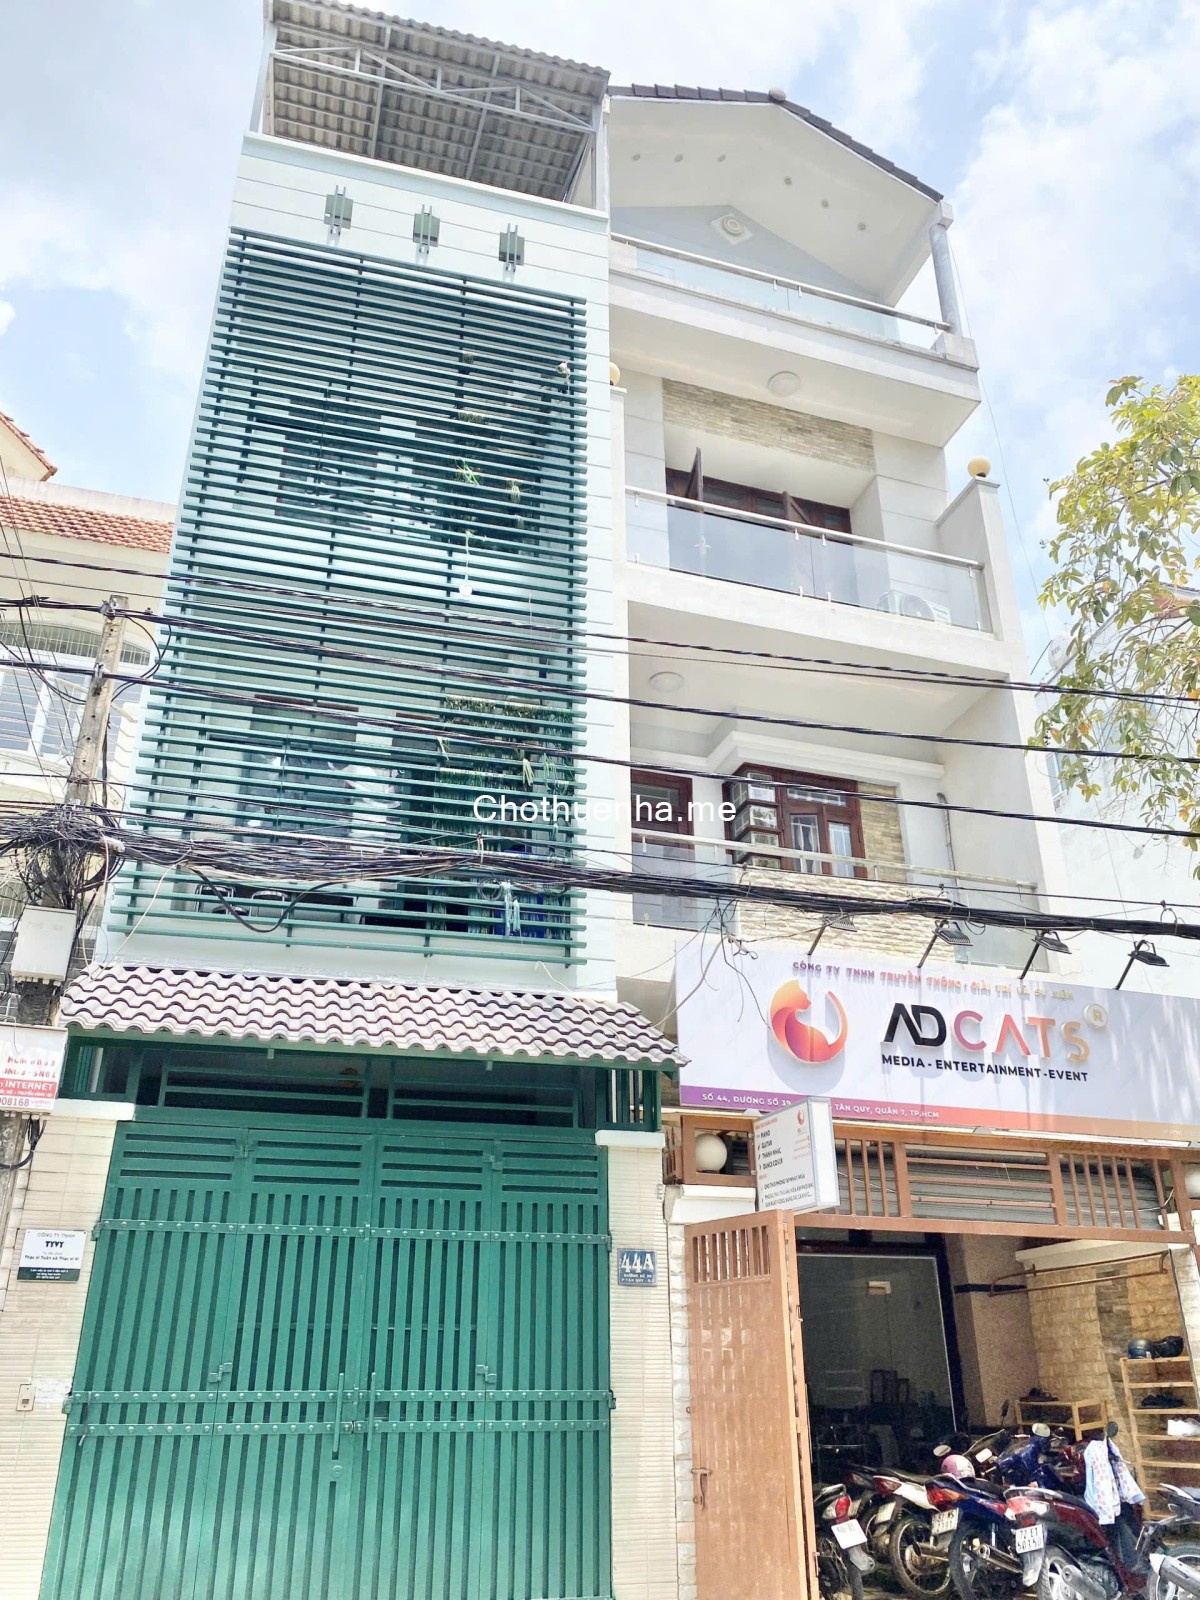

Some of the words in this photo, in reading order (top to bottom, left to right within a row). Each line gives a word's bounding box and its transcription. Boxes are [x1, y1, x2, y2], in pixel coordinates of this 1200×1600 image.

[792, 960, 822, 972] CÔNG
[826, 965, 841, 975] TY
[847, 967, 876, 979] TNHH
[882, 1002, 1091, 1062] ADCATS
[881, 1054, 925, 1068] MEDIA
[936, 1059, 1041, 1079] ENTERTAINMENT
[4, 1080, 54, 1091] INTERNET
[0, 1097, 30, 1107] 08168
[701, 1091, 714, 1101] SỐ
[733, 1095, 765, 1105] ĐƯỜNG
[767, 1097, 779, 1106] SỐ
[834, 1103, 851, 1112] TÂN
[909, 1109, 940, 1118] TP.HCM
[620, 1252, 655, 1273] 44A
